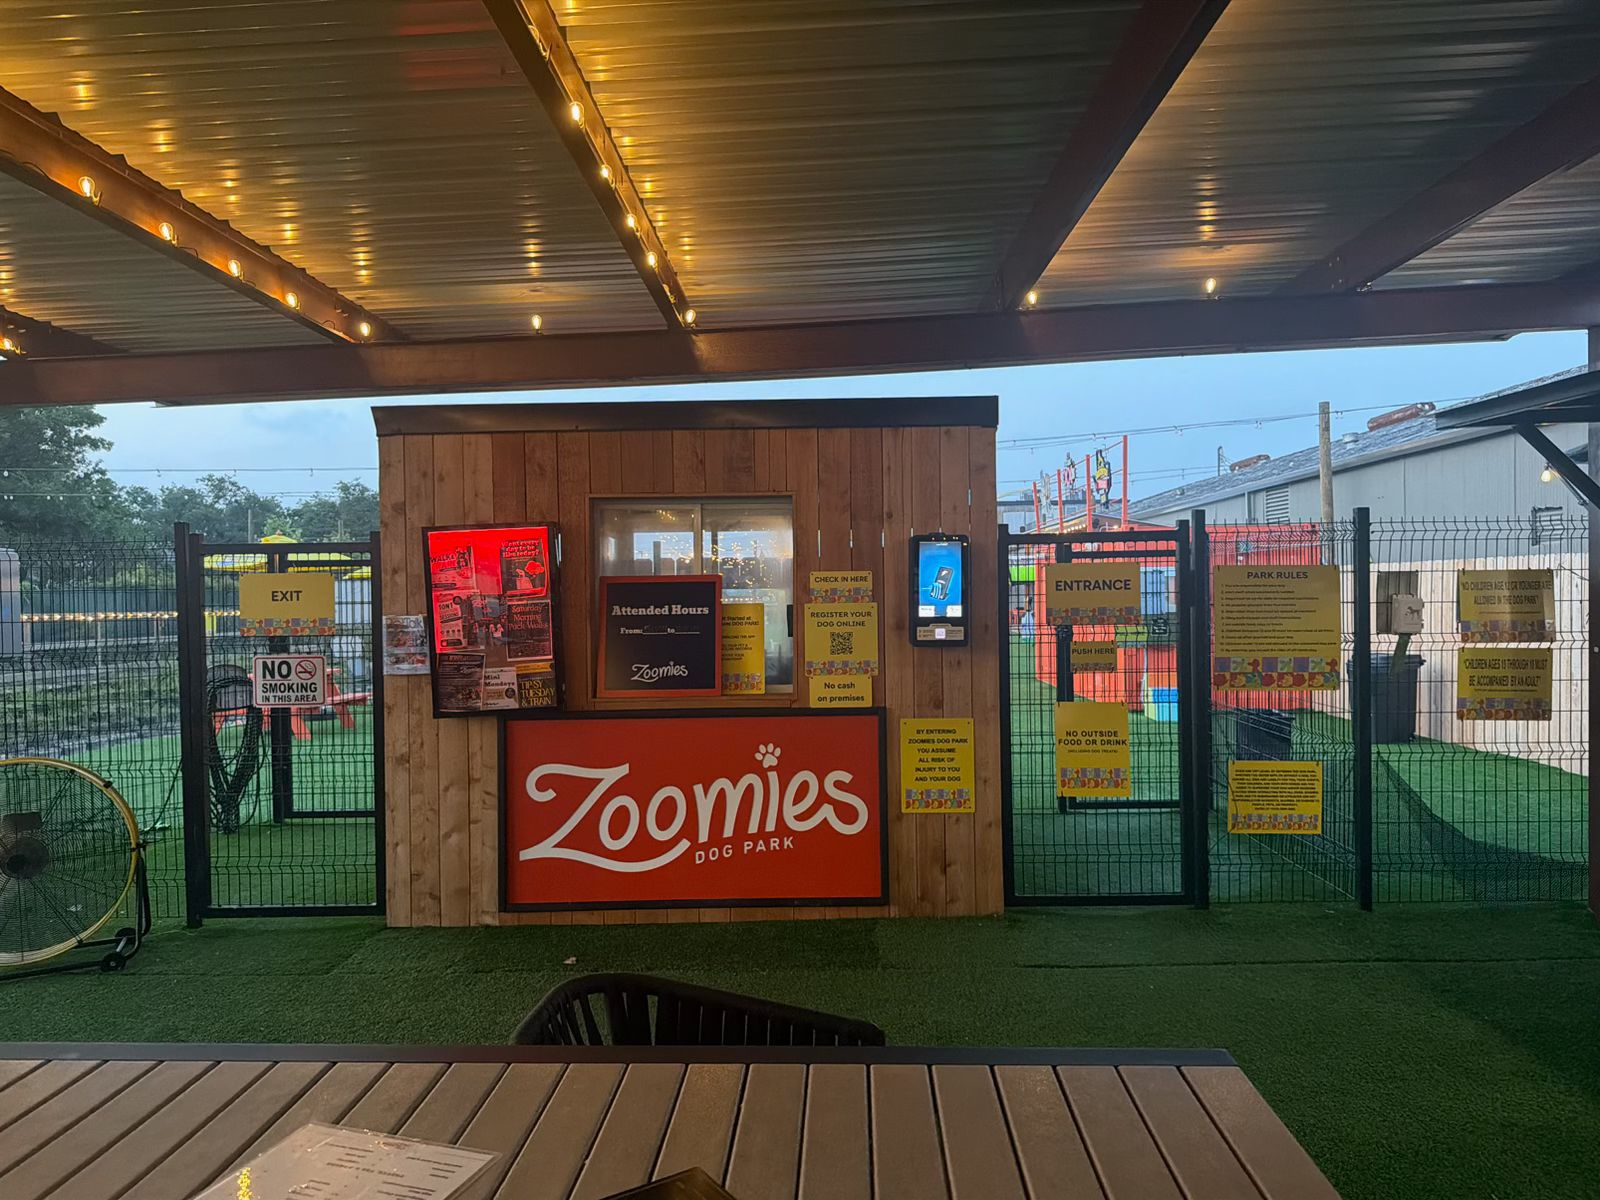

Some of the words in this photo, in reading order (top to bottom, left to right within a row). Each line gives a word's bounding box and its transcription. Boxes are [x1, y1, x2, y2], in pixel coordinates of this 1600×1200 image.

[1247, 571, 1274, 579] PARK
[1276, 571, 1309, 579] RULES
[1055, 579, 1132, 592] ENTRANCE
[271, 590, 303, 602] EXIT
[511, 603, 542, 613] Saturday
[612, 605, 669, 616] Attended
[671, 604, 710, 615] Hours
[262, 660, 292, 680] NO
[630, 660, 688, 683] Zoomies
[262, 682, 318, 694] SMOKING
[521, 680, 543, 690] TIPSY
[837, 681, 856, 689] cash
[262, 695, 271, 703] IN
[273, 695, 292, 703] THIS
[294, 694, 317, 702] AREA
[521, 688, 554, 698] TUESDAY
[829, 694, 865, 703] premises
[530, 697, 552, 707] TRAIN
[519, 743, 869, 873] Zoomies
[694, 845, 734, 864] DOG
[743, 836, 794, 854] PARK
